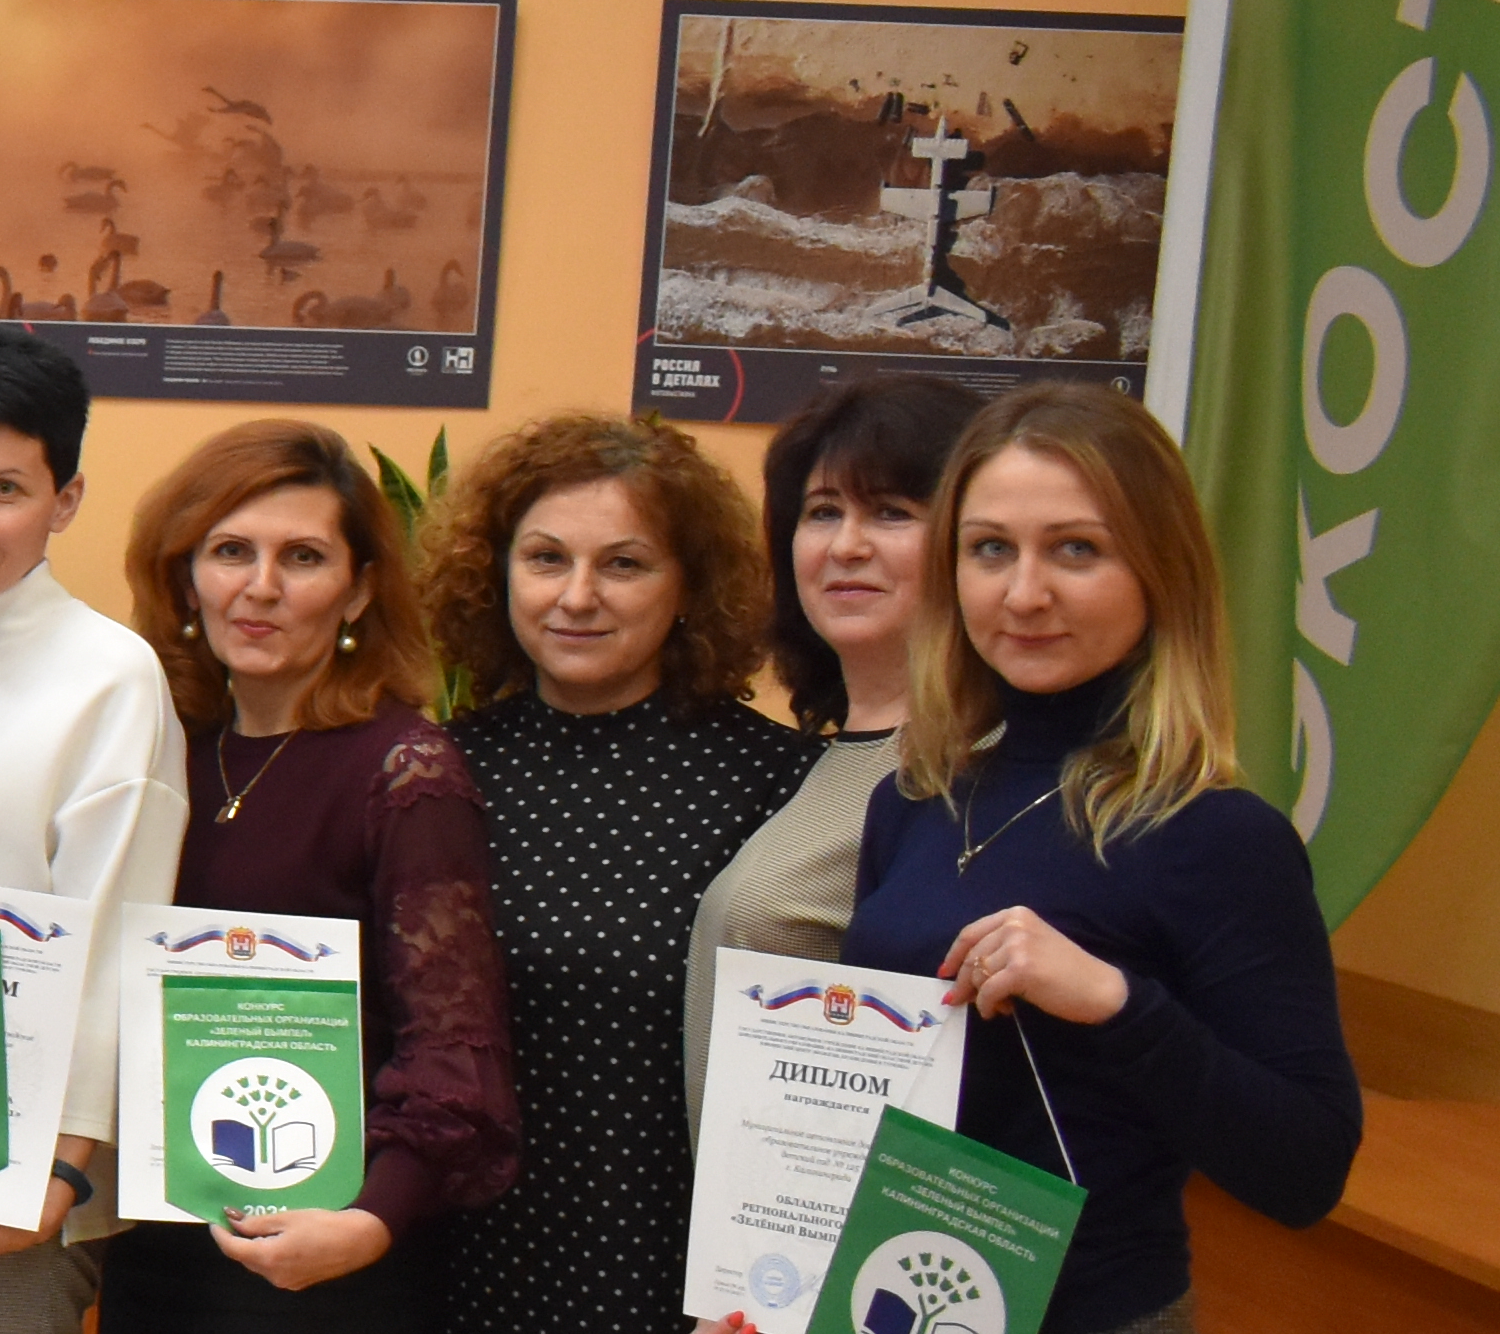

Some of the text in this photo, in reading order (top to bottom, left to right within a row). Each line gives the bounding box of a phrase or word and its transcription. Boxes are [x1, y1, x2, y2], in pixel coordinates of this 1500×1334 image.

[653, 359, 700, 373] РОССИЯ
[237, 1002, 284, 1011] КОНКУРС
[769, 1059, 891, 1097] ДИПЛОМ
[784, 1093, 870, 1115] награждается
[949, 1166, 998, 1194] КОНКУРС
